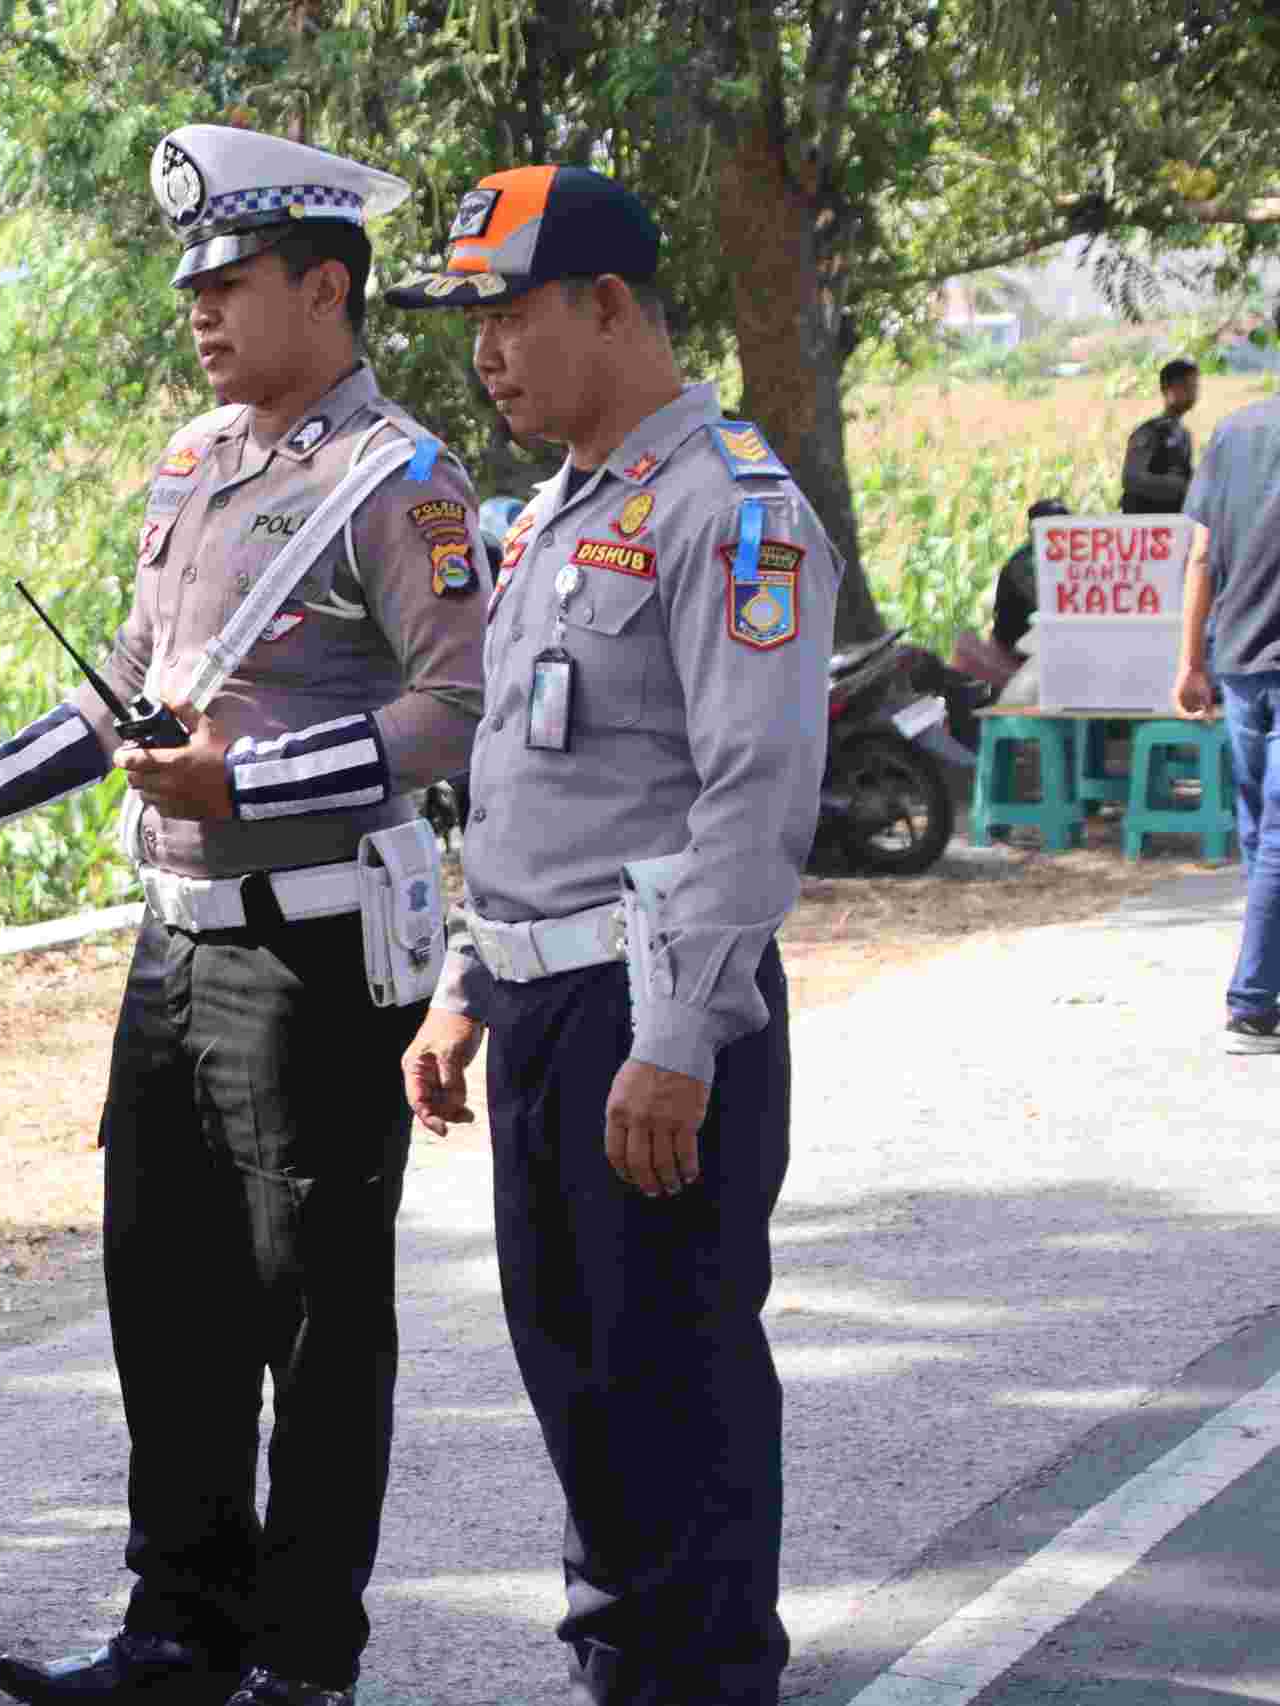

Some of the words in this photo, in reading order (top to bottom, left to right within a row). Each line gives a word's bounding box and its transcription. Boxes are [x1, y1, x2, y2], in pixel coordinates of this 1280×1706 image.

[578, 544, 643, 569] DISHUB
[1045, 528, 1172, 561] SERVIS
[1057, 584, 1160, 614] KACA
